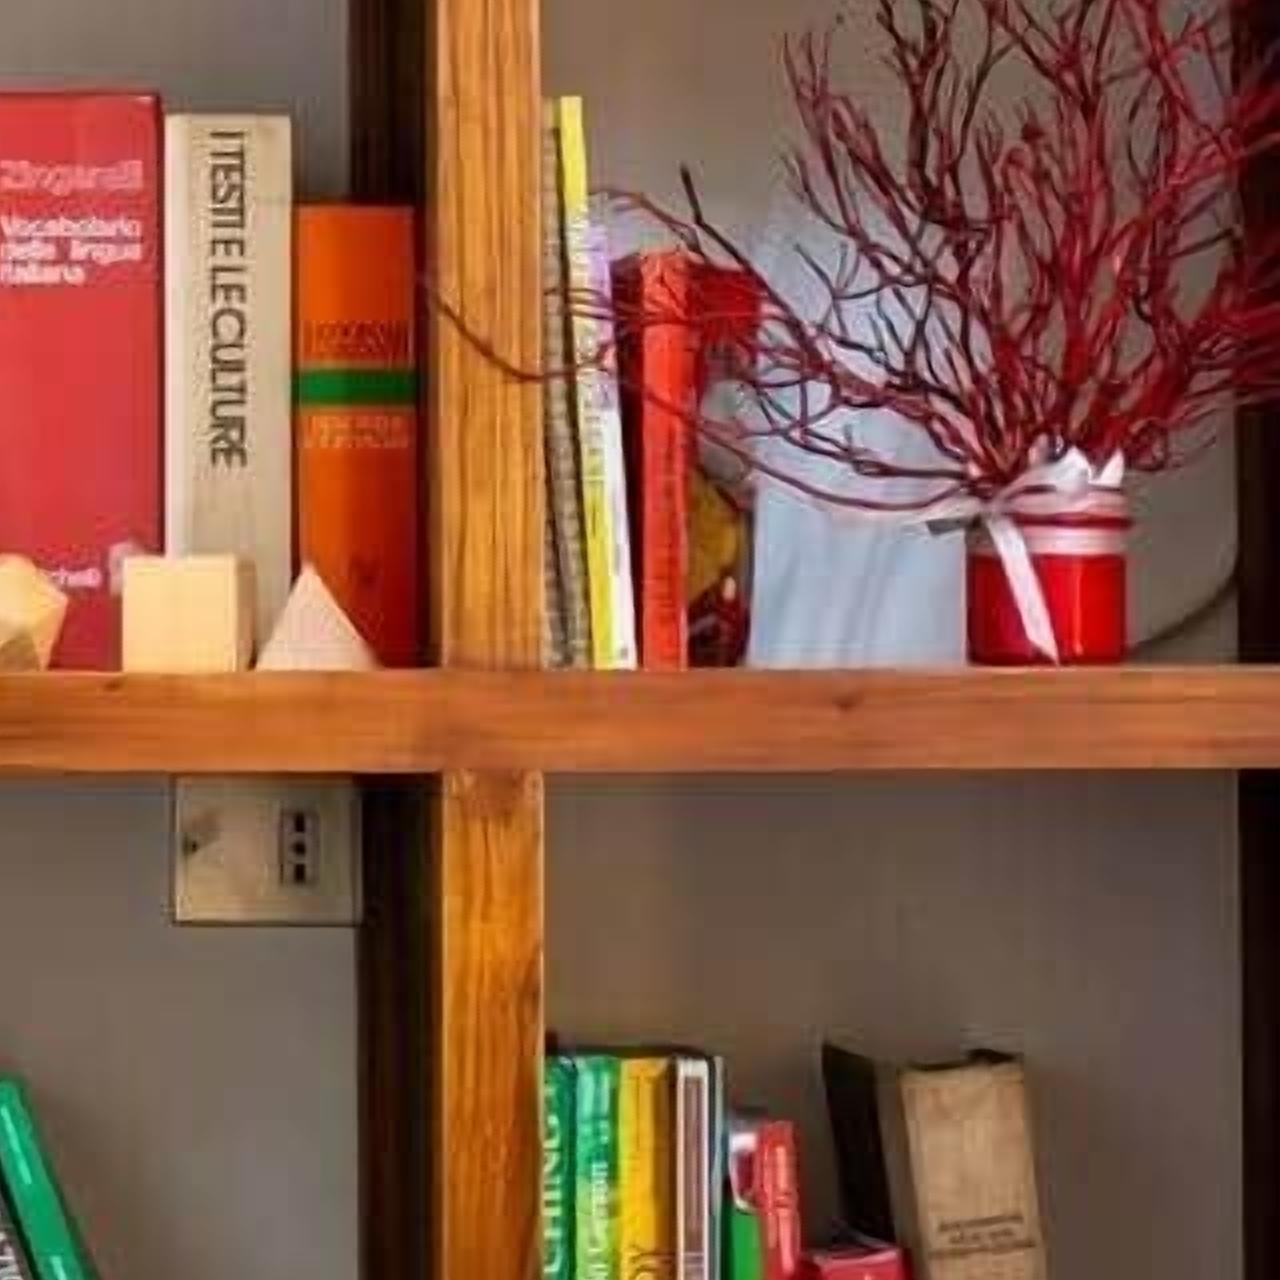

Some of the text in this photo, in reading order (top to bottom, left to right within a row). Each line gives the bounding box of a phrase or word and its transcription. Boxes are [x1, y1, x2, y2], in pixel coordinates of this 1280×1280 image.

[208, 149, 248, 229] TESTI
[208, 240, 247, 257] E
[208, 267, 248, 301] LE
[208, 308, 248, 467] CULTURE
